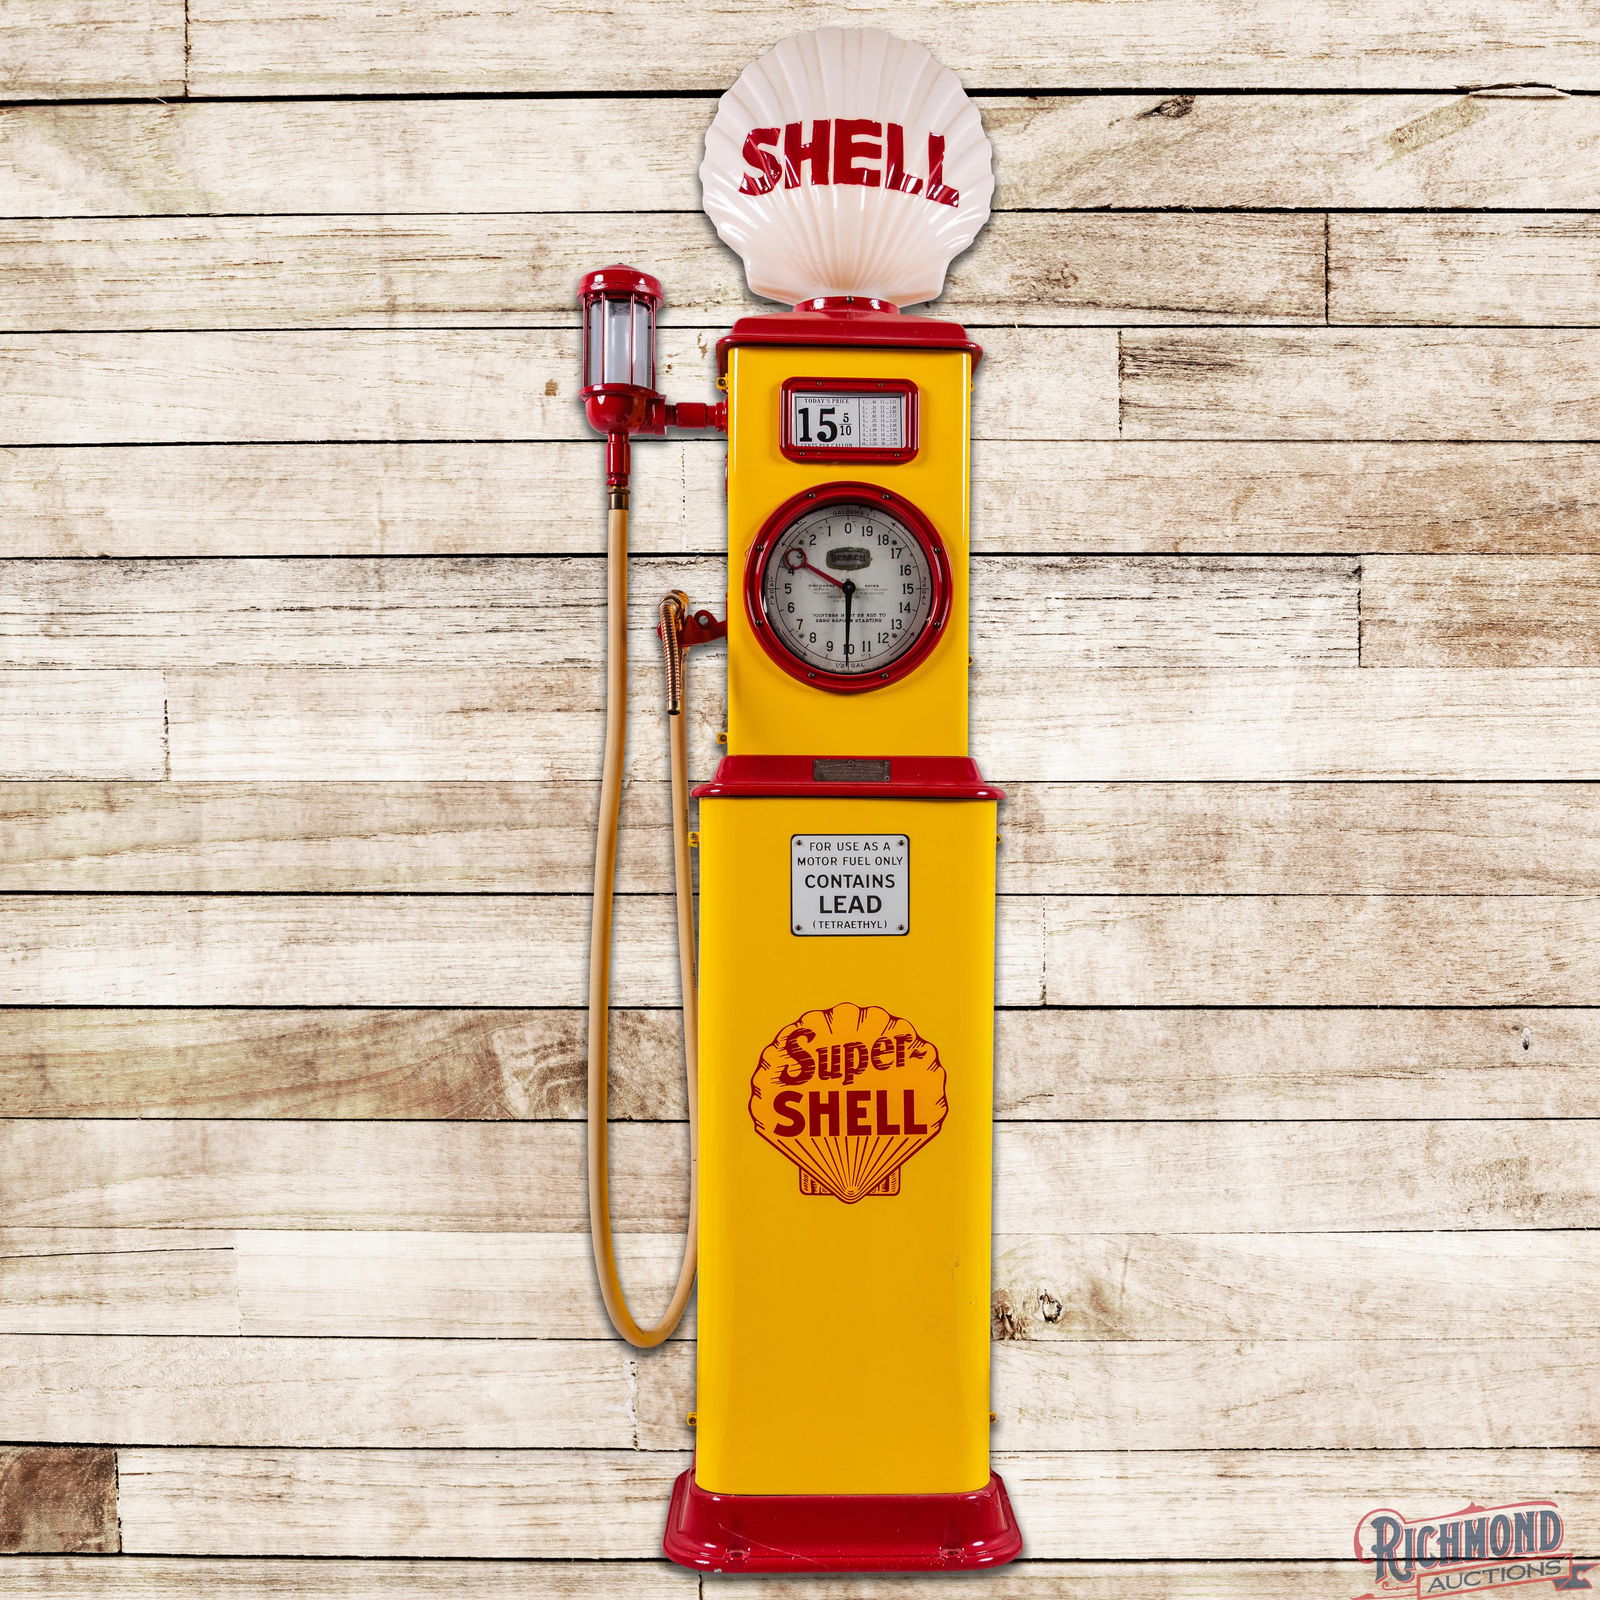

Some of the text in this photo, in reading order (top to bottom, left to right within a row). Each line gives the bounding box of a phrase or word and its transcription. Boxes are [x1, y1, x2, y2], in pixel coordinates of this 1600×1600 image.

[738, 118, 960, 208] SHELL
[843, 413, 850, 423] 5
[798, 407, 838, 443] 15
[840, 425, 852, 436] 10
[826, 526, 831, 537] 1
[844, 523, 852, 534] 0
[861, 526, 874, 537] 19
[809, 534, 817, 546] 2
[877, 534, 889, 546] 18
[891, 548, 903, 559] 17
[899, 565, 912, 576] 16
[784, 583, 792, 594] 5
[902, 583, 914, 595] 15
[787, 602, 795, 613] 6
[899, 602, 911, 613] 14
[796, 619, 804, 630] 7
[891, 619, 902, 630] 13
[809, 632, 817, 643] 8
[877, 632, 889, 644] 12
[826, 640, 834, 652] 9
[862, 640, 872, 652] 11
[809, 842, 891, 851] FOR USE AS A
[797, 857, 903, 866] MOTOR FUEL ONLY
[804, 874, 895, 888] CONTAINS
[819, 895, 882, 914] LEAD
[773, 1089, 928, 1137] SHELL
